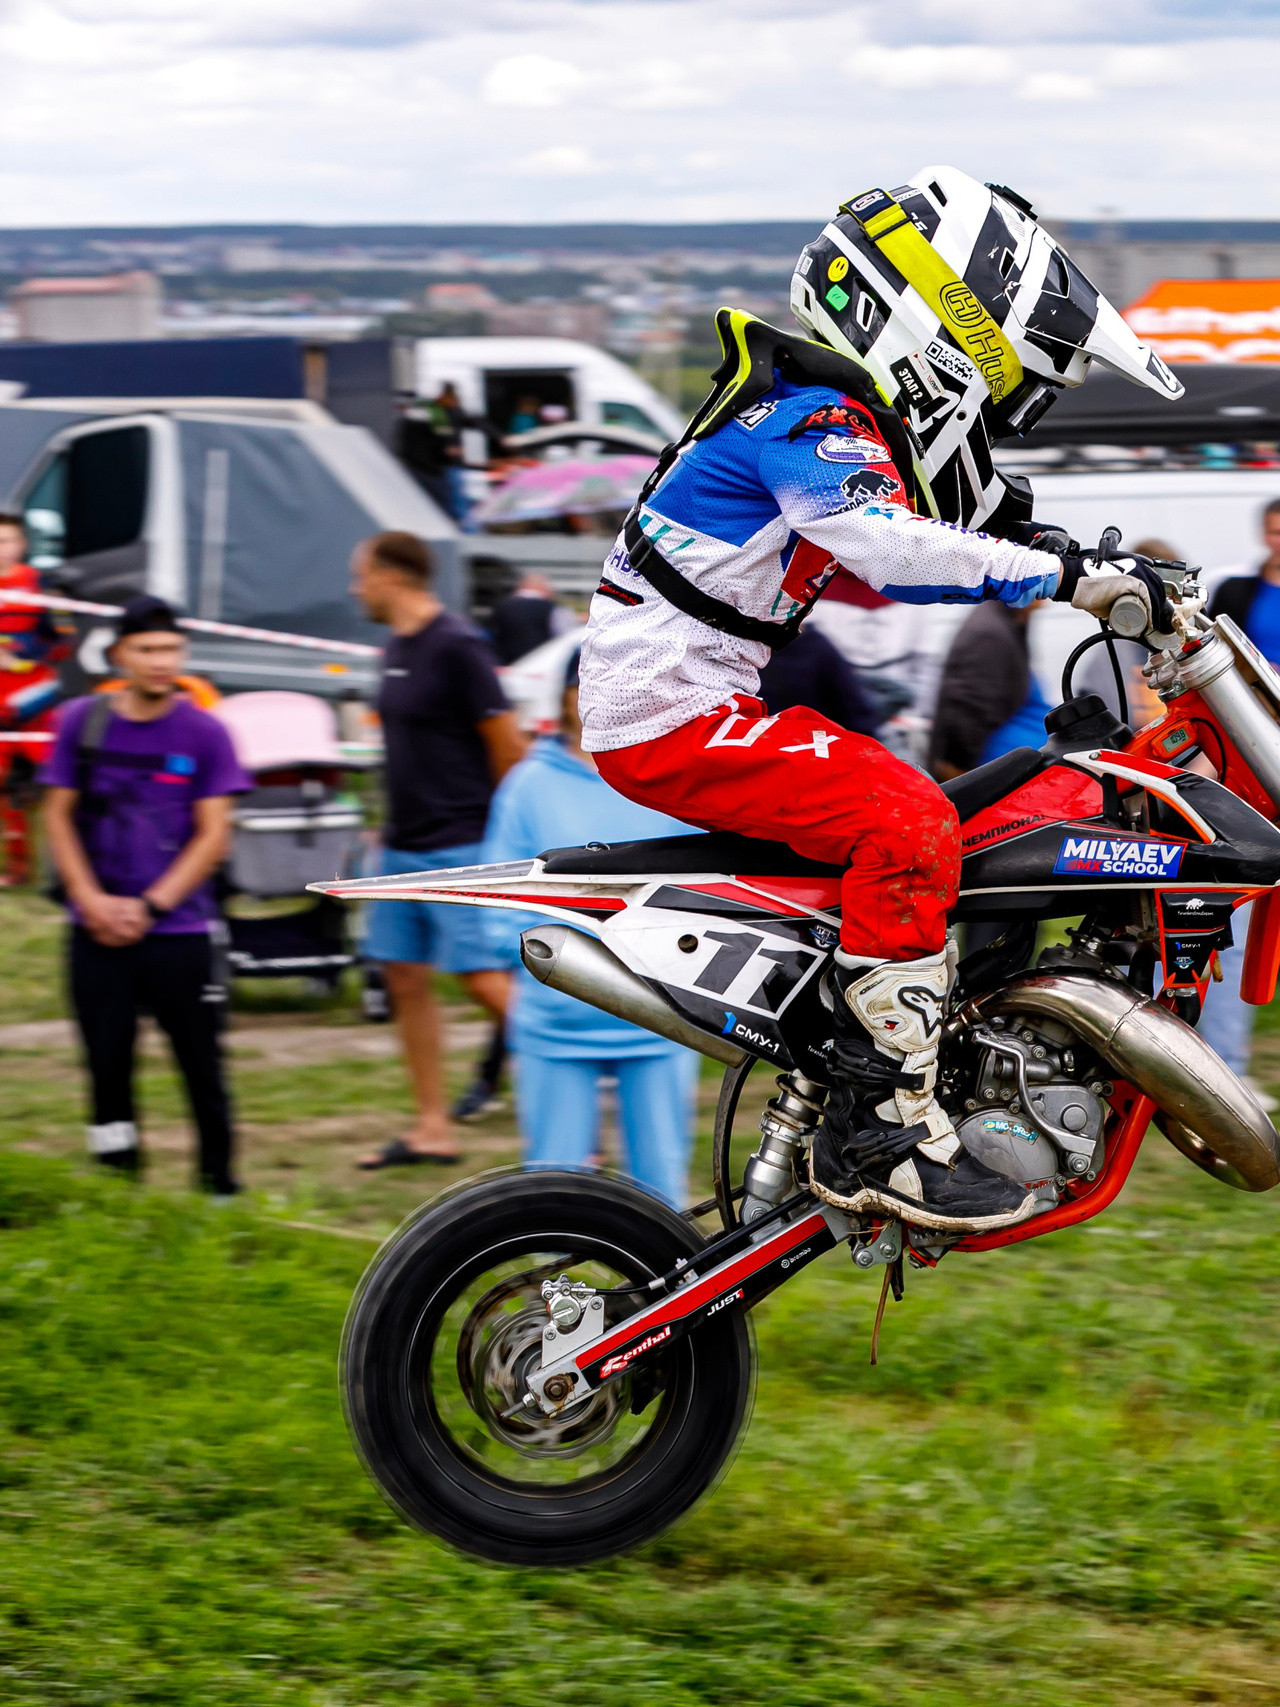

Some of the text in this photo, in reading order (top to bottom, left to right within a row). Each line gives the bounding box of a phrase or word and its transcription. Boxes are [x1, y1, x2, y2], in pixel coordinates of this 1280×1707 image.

[898, 367, 919, 393] ЭТАП
[912, 391, 923, 401] 2
[1063, 838, 1181, 864] MILYAEV
[1076, 859, 1167, 876] MX SCHOOL
[693, 930, 819, 1014] 11
[735, 1023, 780, 1053] СМУ-1
[789, 1247, 812, 1264] brembo
[599, 1325, 672, 1379] Renthal
